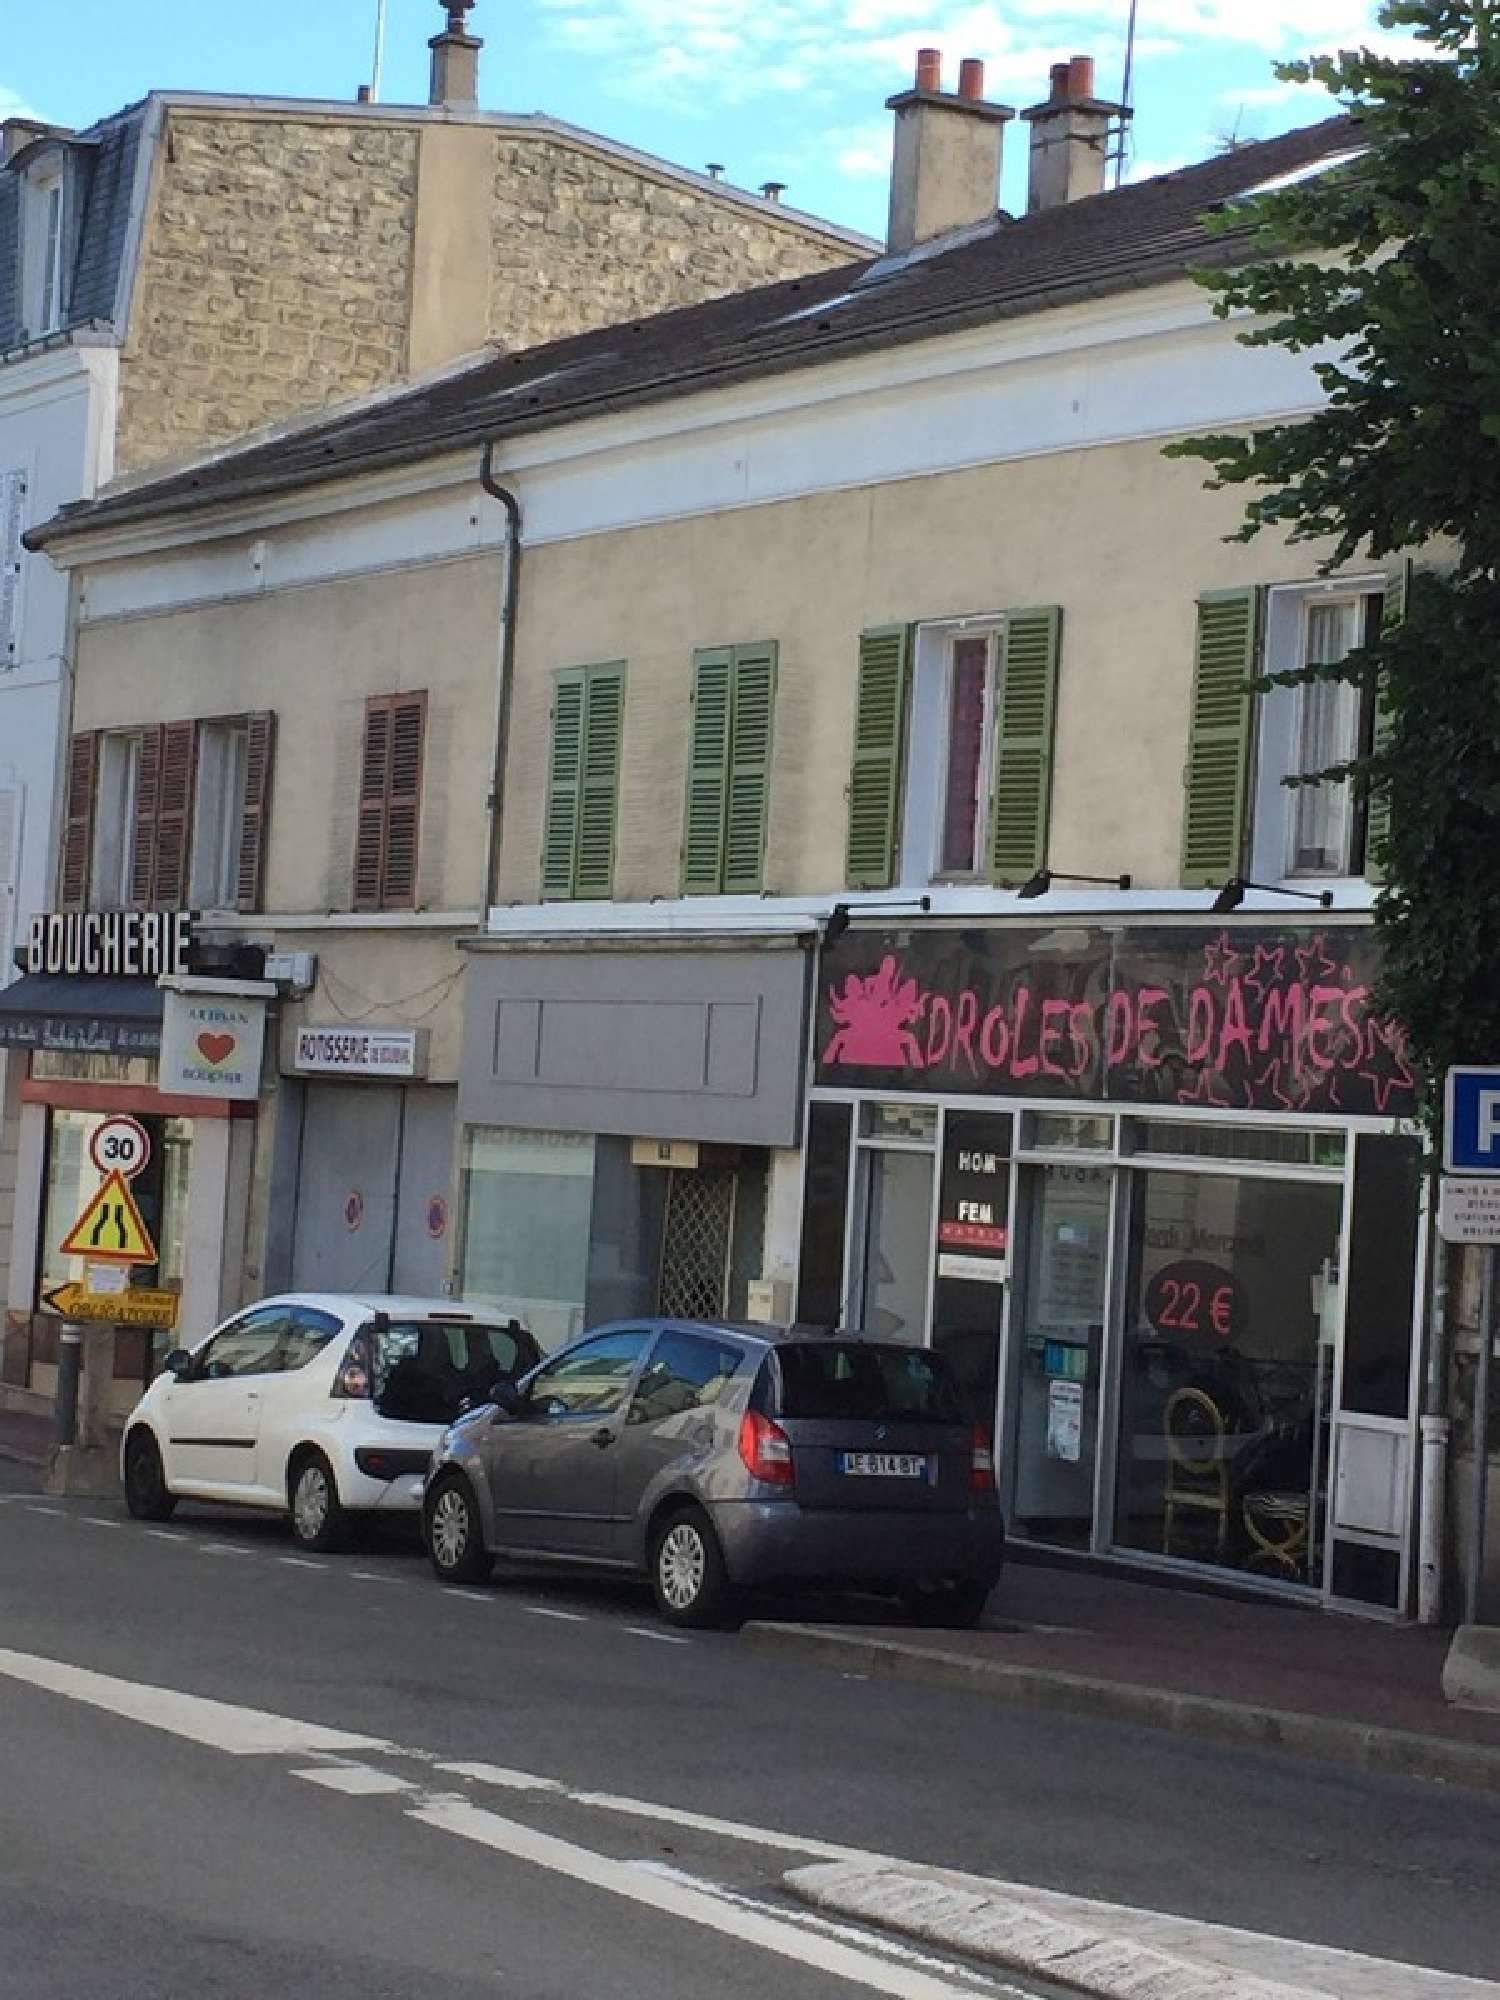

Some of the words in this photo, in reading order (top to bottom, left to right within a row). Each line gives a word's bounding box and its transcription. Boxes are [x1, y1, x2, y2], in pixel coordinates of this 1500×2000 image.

[28, 912, 190, 974] BOUCHERIE
[926, 988, 1091, 1082] DROLES
[1108, 988, 1169, 1066] DE
[1187, 977, 1370, 1082] DAMES
[104, 1135, 134, 1160] 30
[1159, 1279, 1200, 1329] 22
[1209, 1285, 1234, 1335] €
